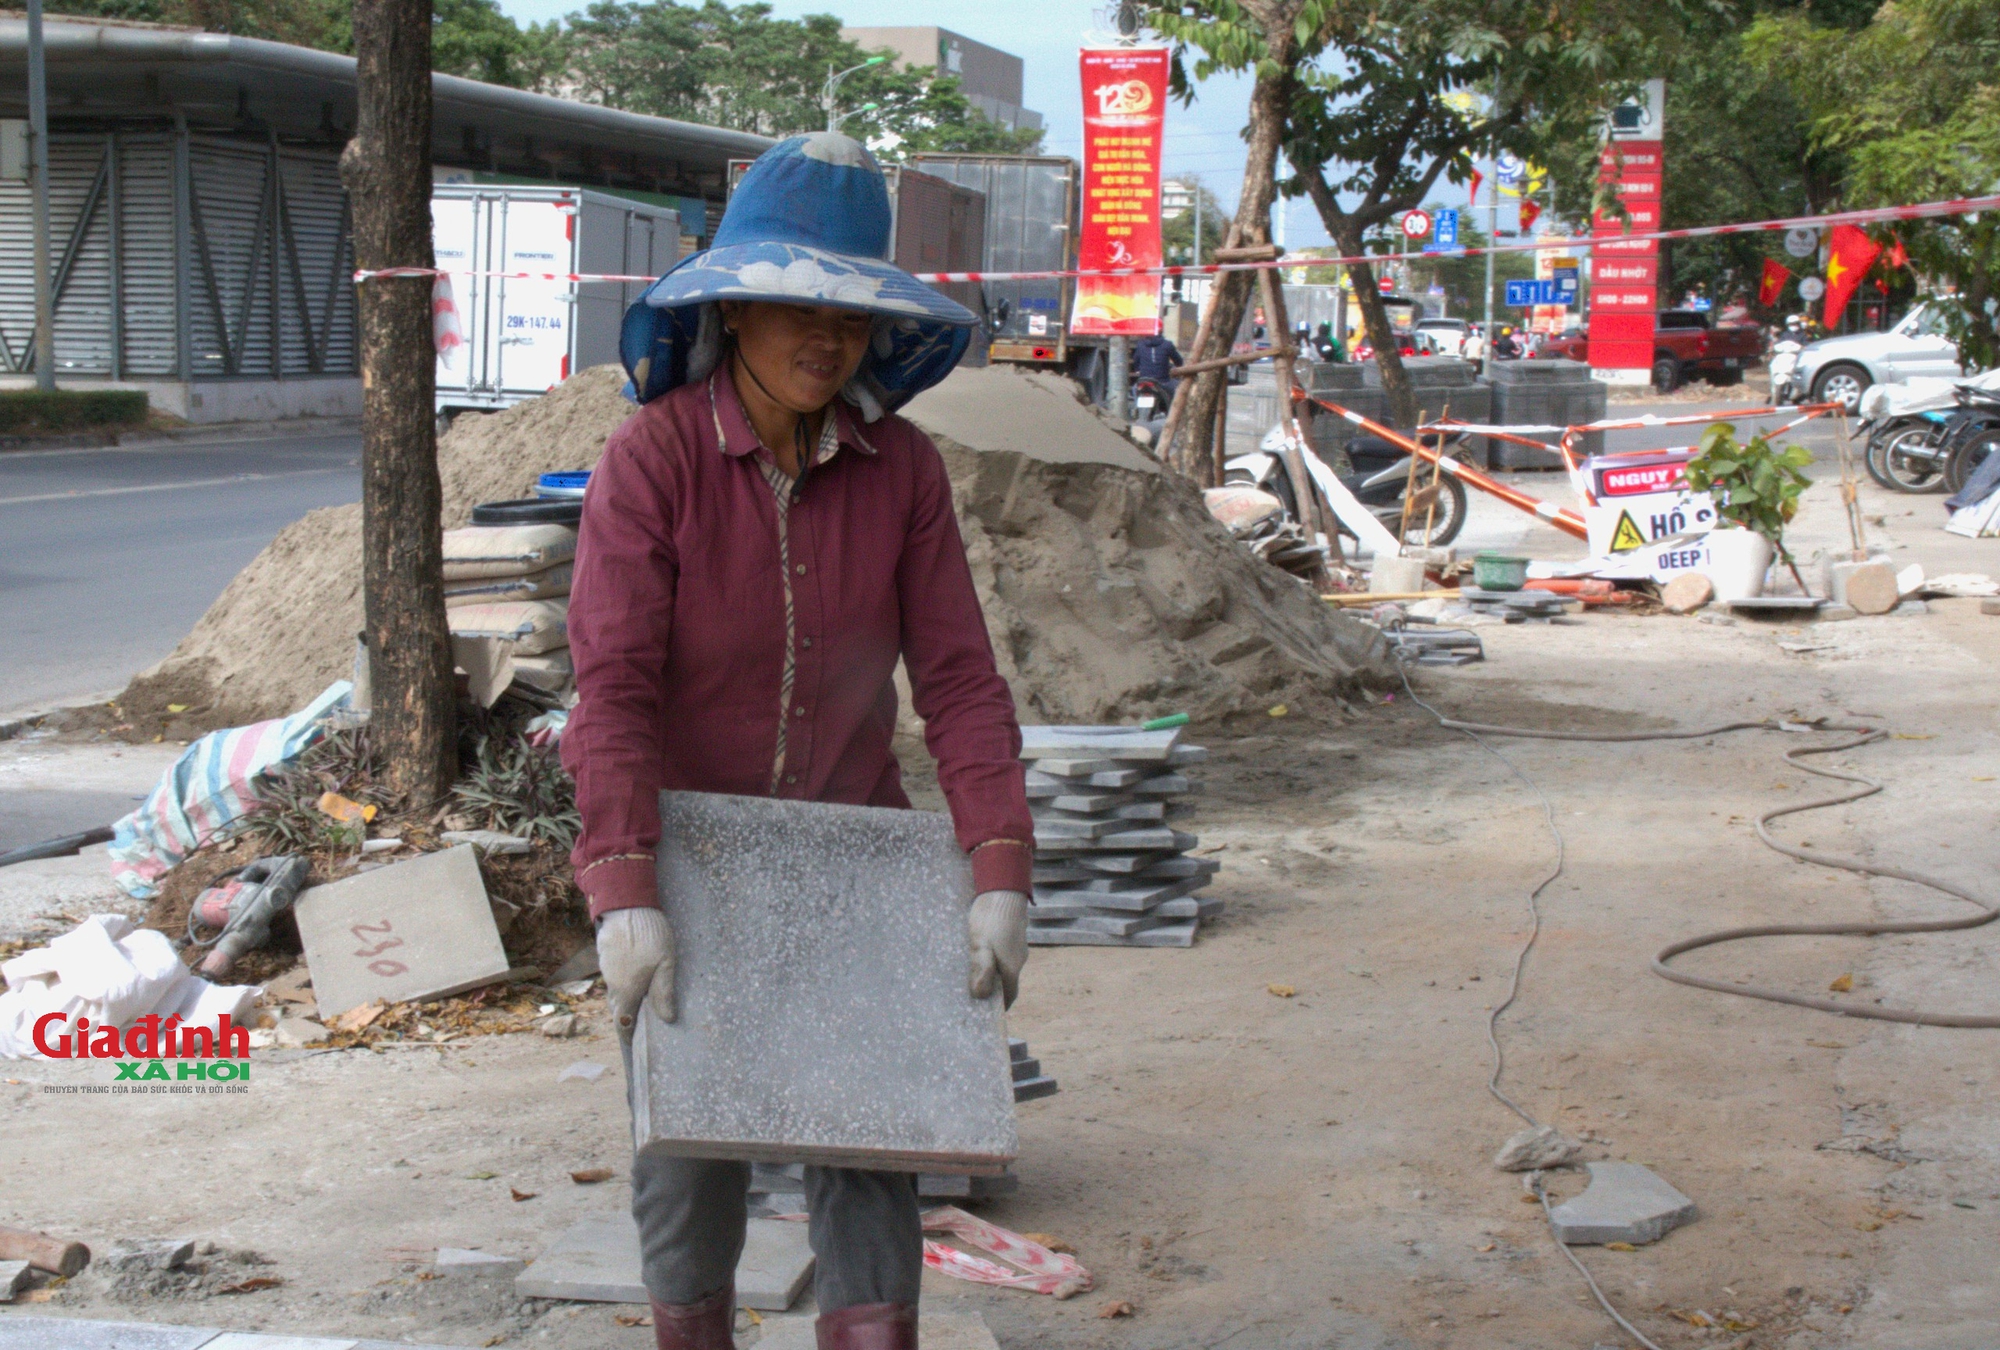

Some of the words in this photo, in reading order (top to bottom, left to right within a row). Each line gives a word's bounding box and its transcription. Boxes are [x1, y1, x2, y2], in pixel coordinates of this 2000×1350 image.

[1599, 263, 1619, 278] DẦU
[507, 315, 561, 329] 29K-147.44
[1609, 470, 1669, 487] NGUY
[1658, 549, 1701, 569] DEEP
